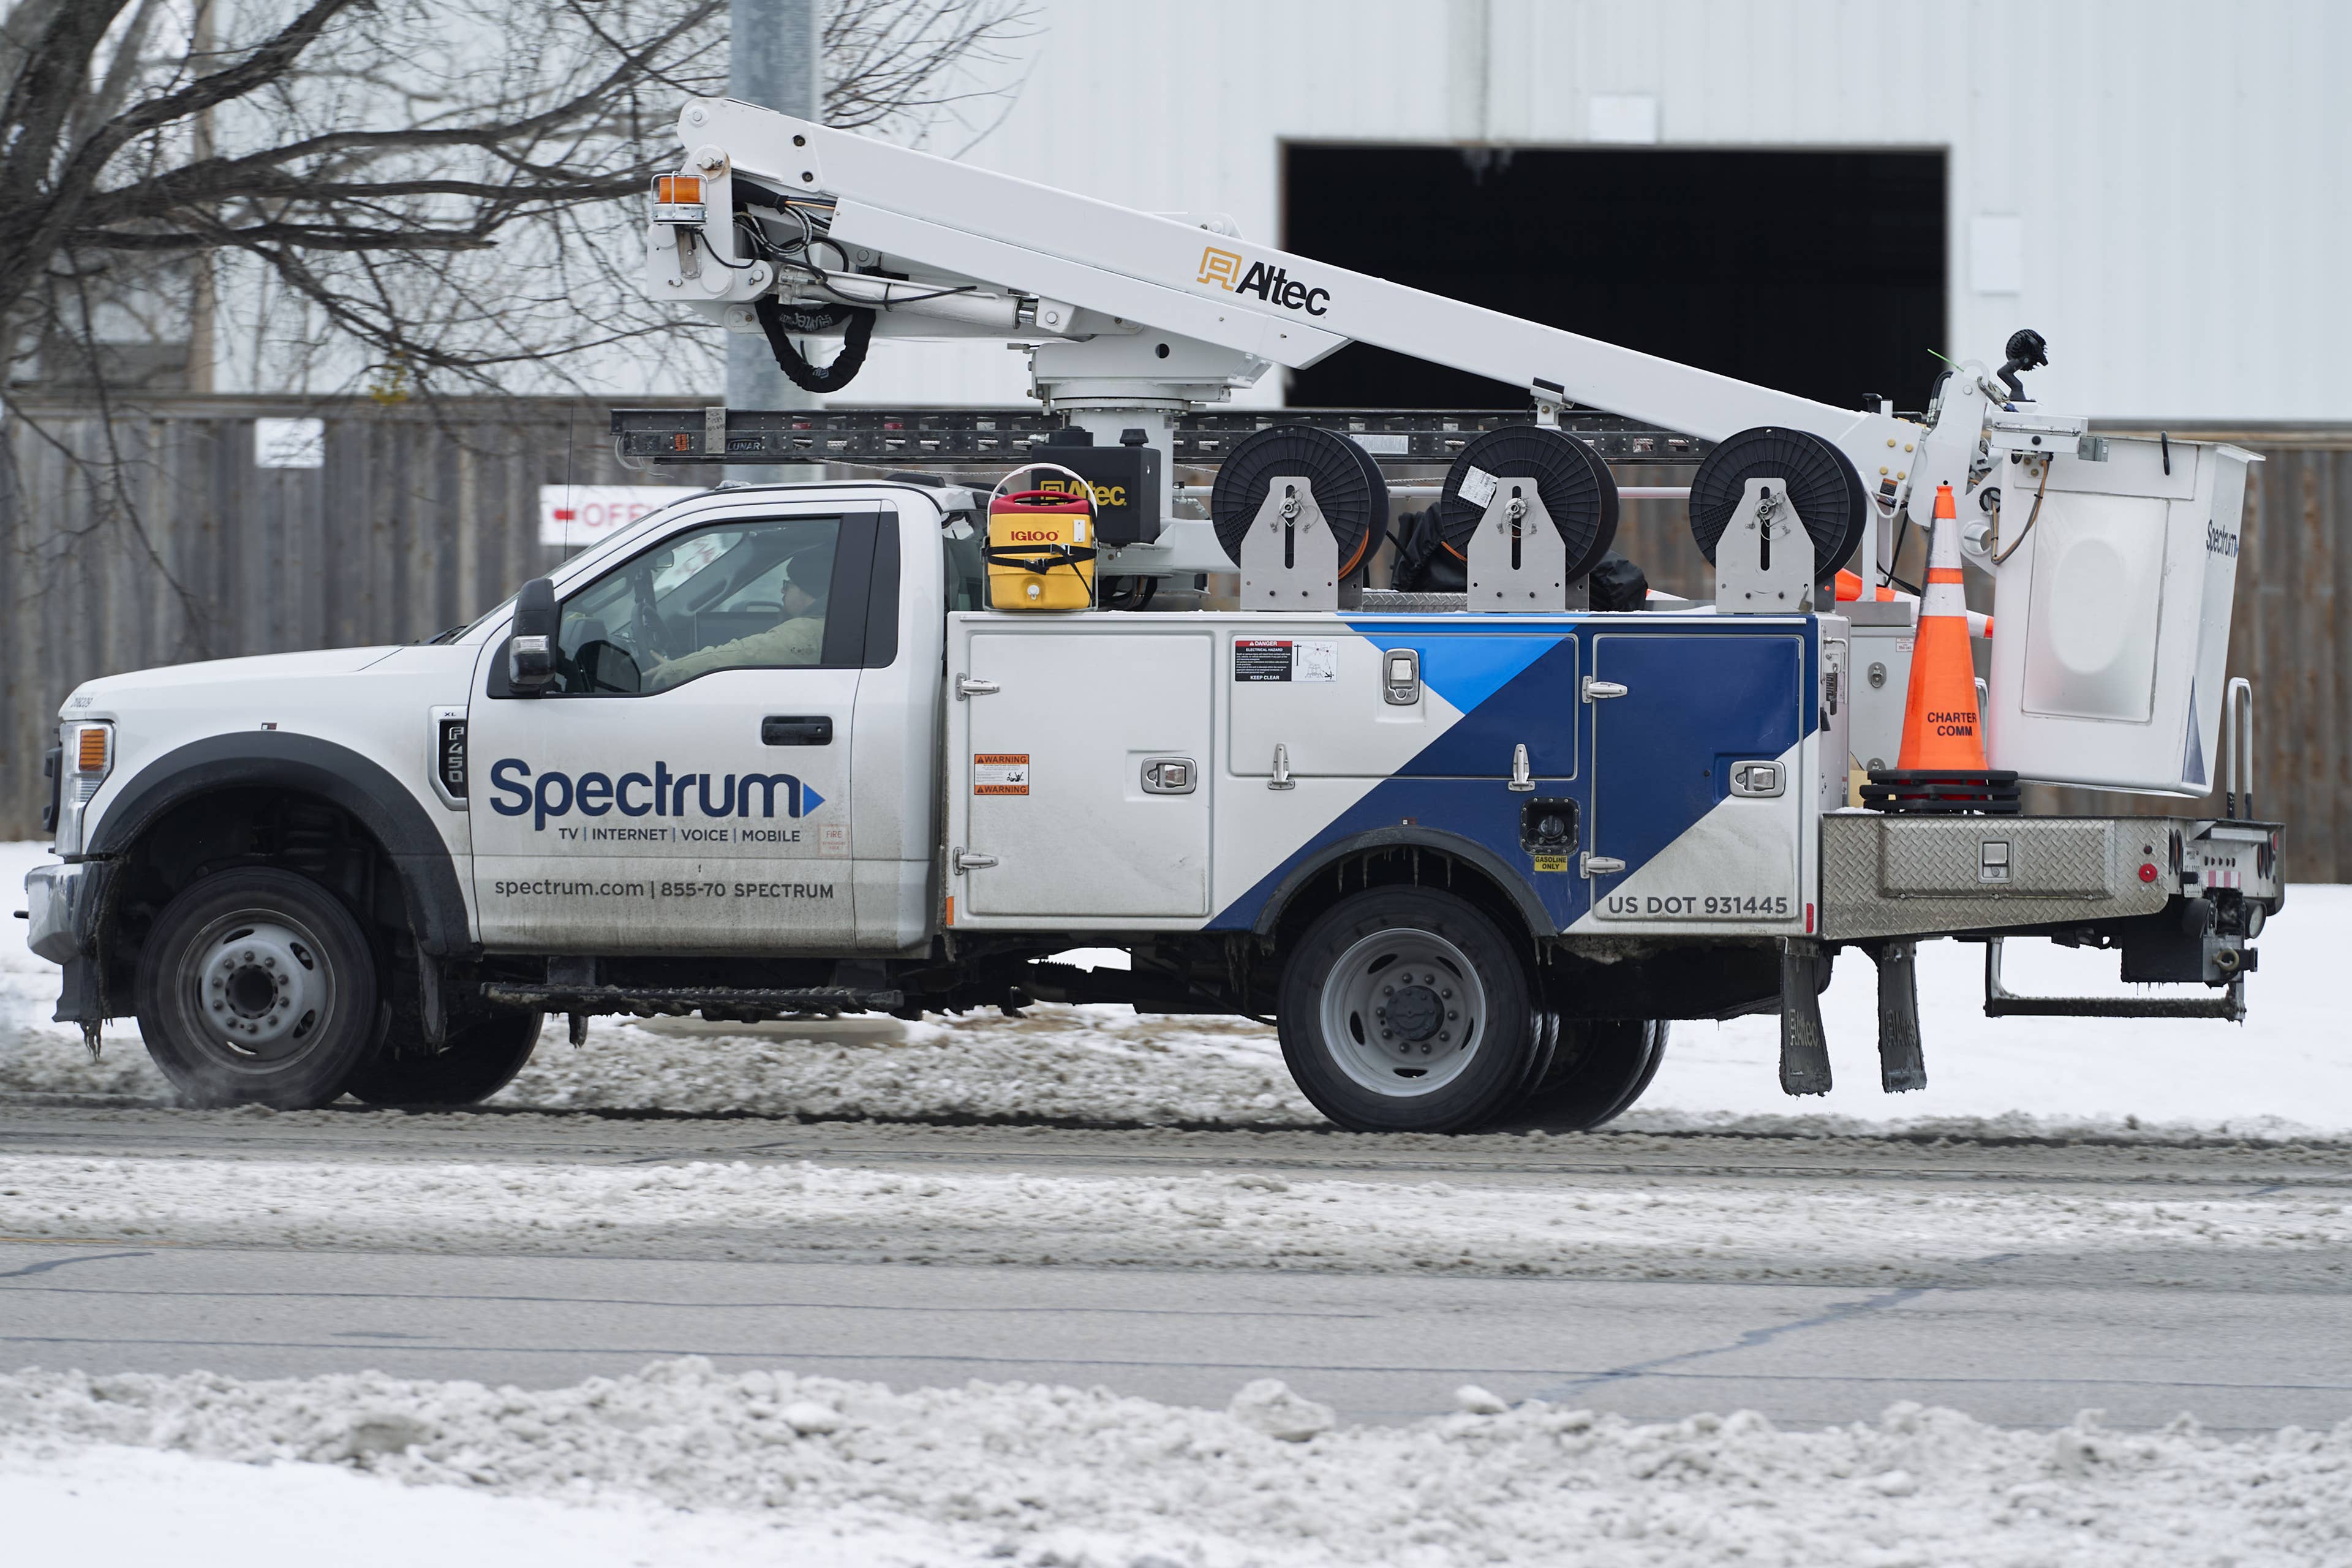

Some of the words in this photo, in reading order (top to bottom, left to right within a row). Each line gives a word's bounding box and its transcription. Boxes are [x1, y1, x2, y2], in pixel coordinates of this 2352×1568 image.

[1235, 262, 1330, 315] Altec
[727, 442, 761, 451] LUNAR
[583, 503, 653, 527] OFF
[1011, 531, 1058, 541] IGLOO
[2206, 519, 2236, 559] Spectrum
[1928, 712, 1977, 723] CHARTER
[1937, 726, 1973, 736] COMM
[490, 758, 801, 831] Spectrum
[559, 828, 579, 839] TV
[592, 828, 668, 840] INTERNET
[680, 829, 728, 841] VOICE
[742, 830, 801, 842] MOBILE
[495, 878, 644, 897] spectrum.com
[661, 882, 726, 897] 855-70
[734, 883, 834, 899] SPECTRUM
[1608, 897, 1638, 914] US
[1647, 897, 1697, 914] DOT
[1704, 897, 1788, 914] 931445
